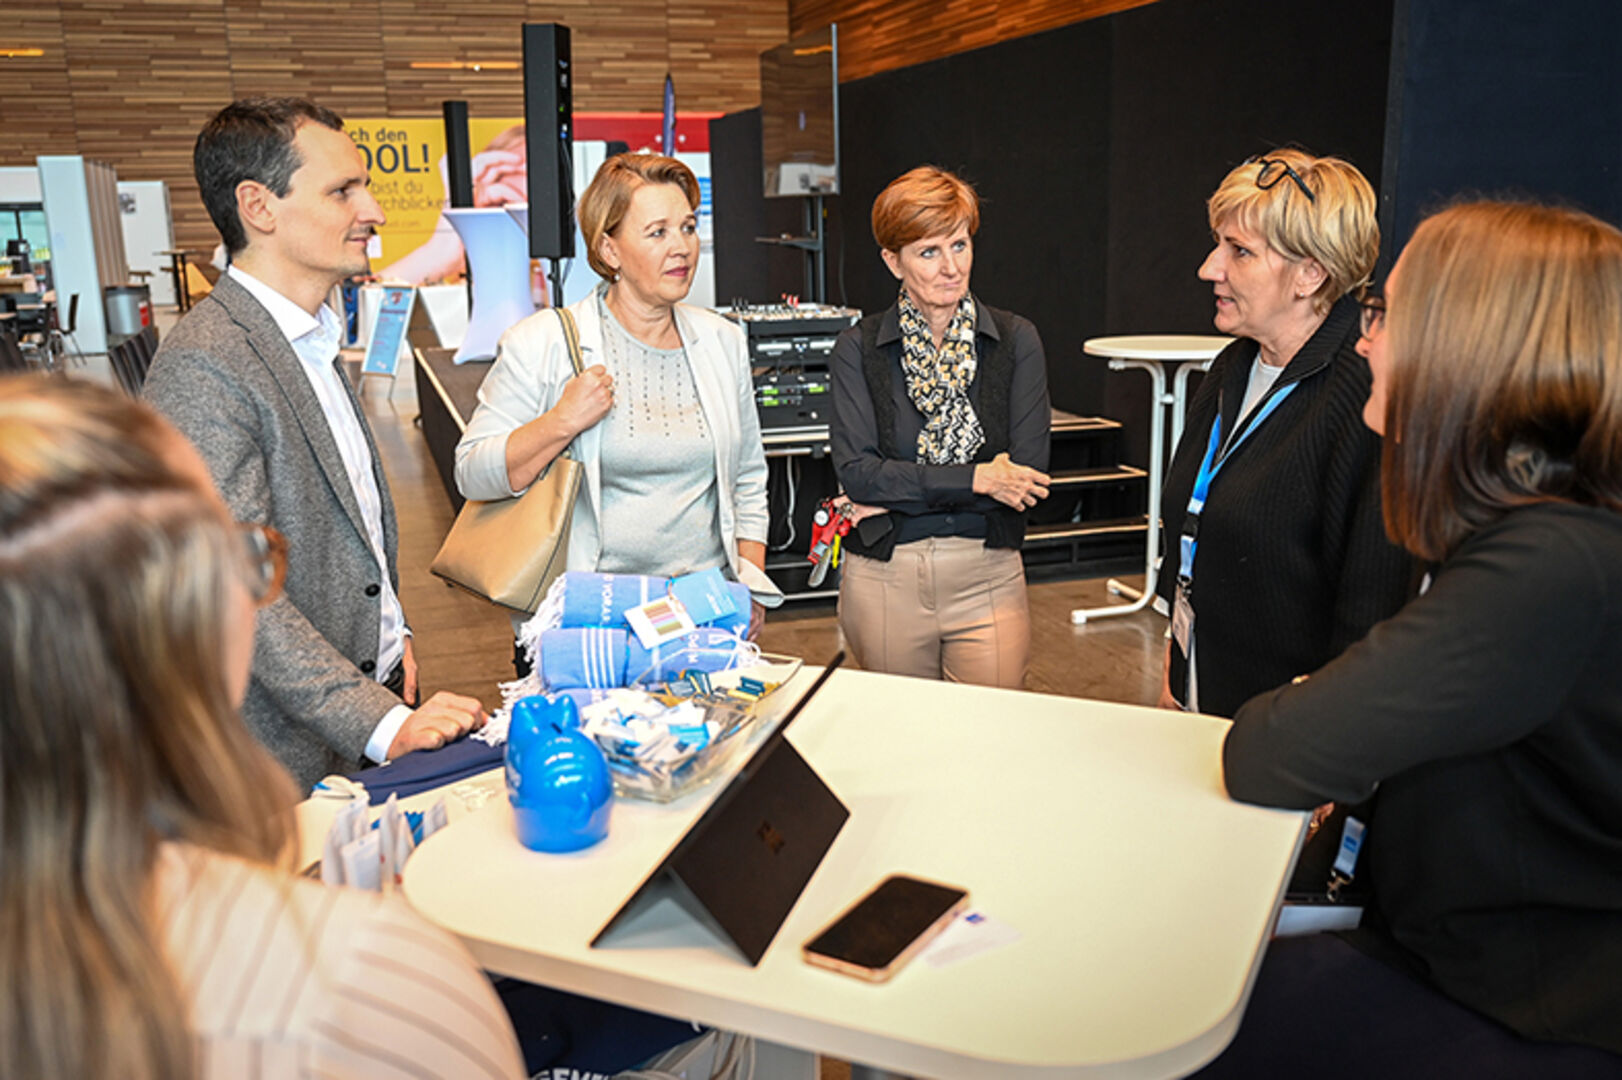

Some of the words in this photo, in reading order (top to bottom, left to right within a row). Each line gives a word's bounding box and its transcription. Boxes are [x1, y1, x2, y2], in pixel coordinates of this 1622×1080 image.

[375, 127, 407, 142] den
[371, 180, 399, 194] bist
[404, 180, 423, 194] du
